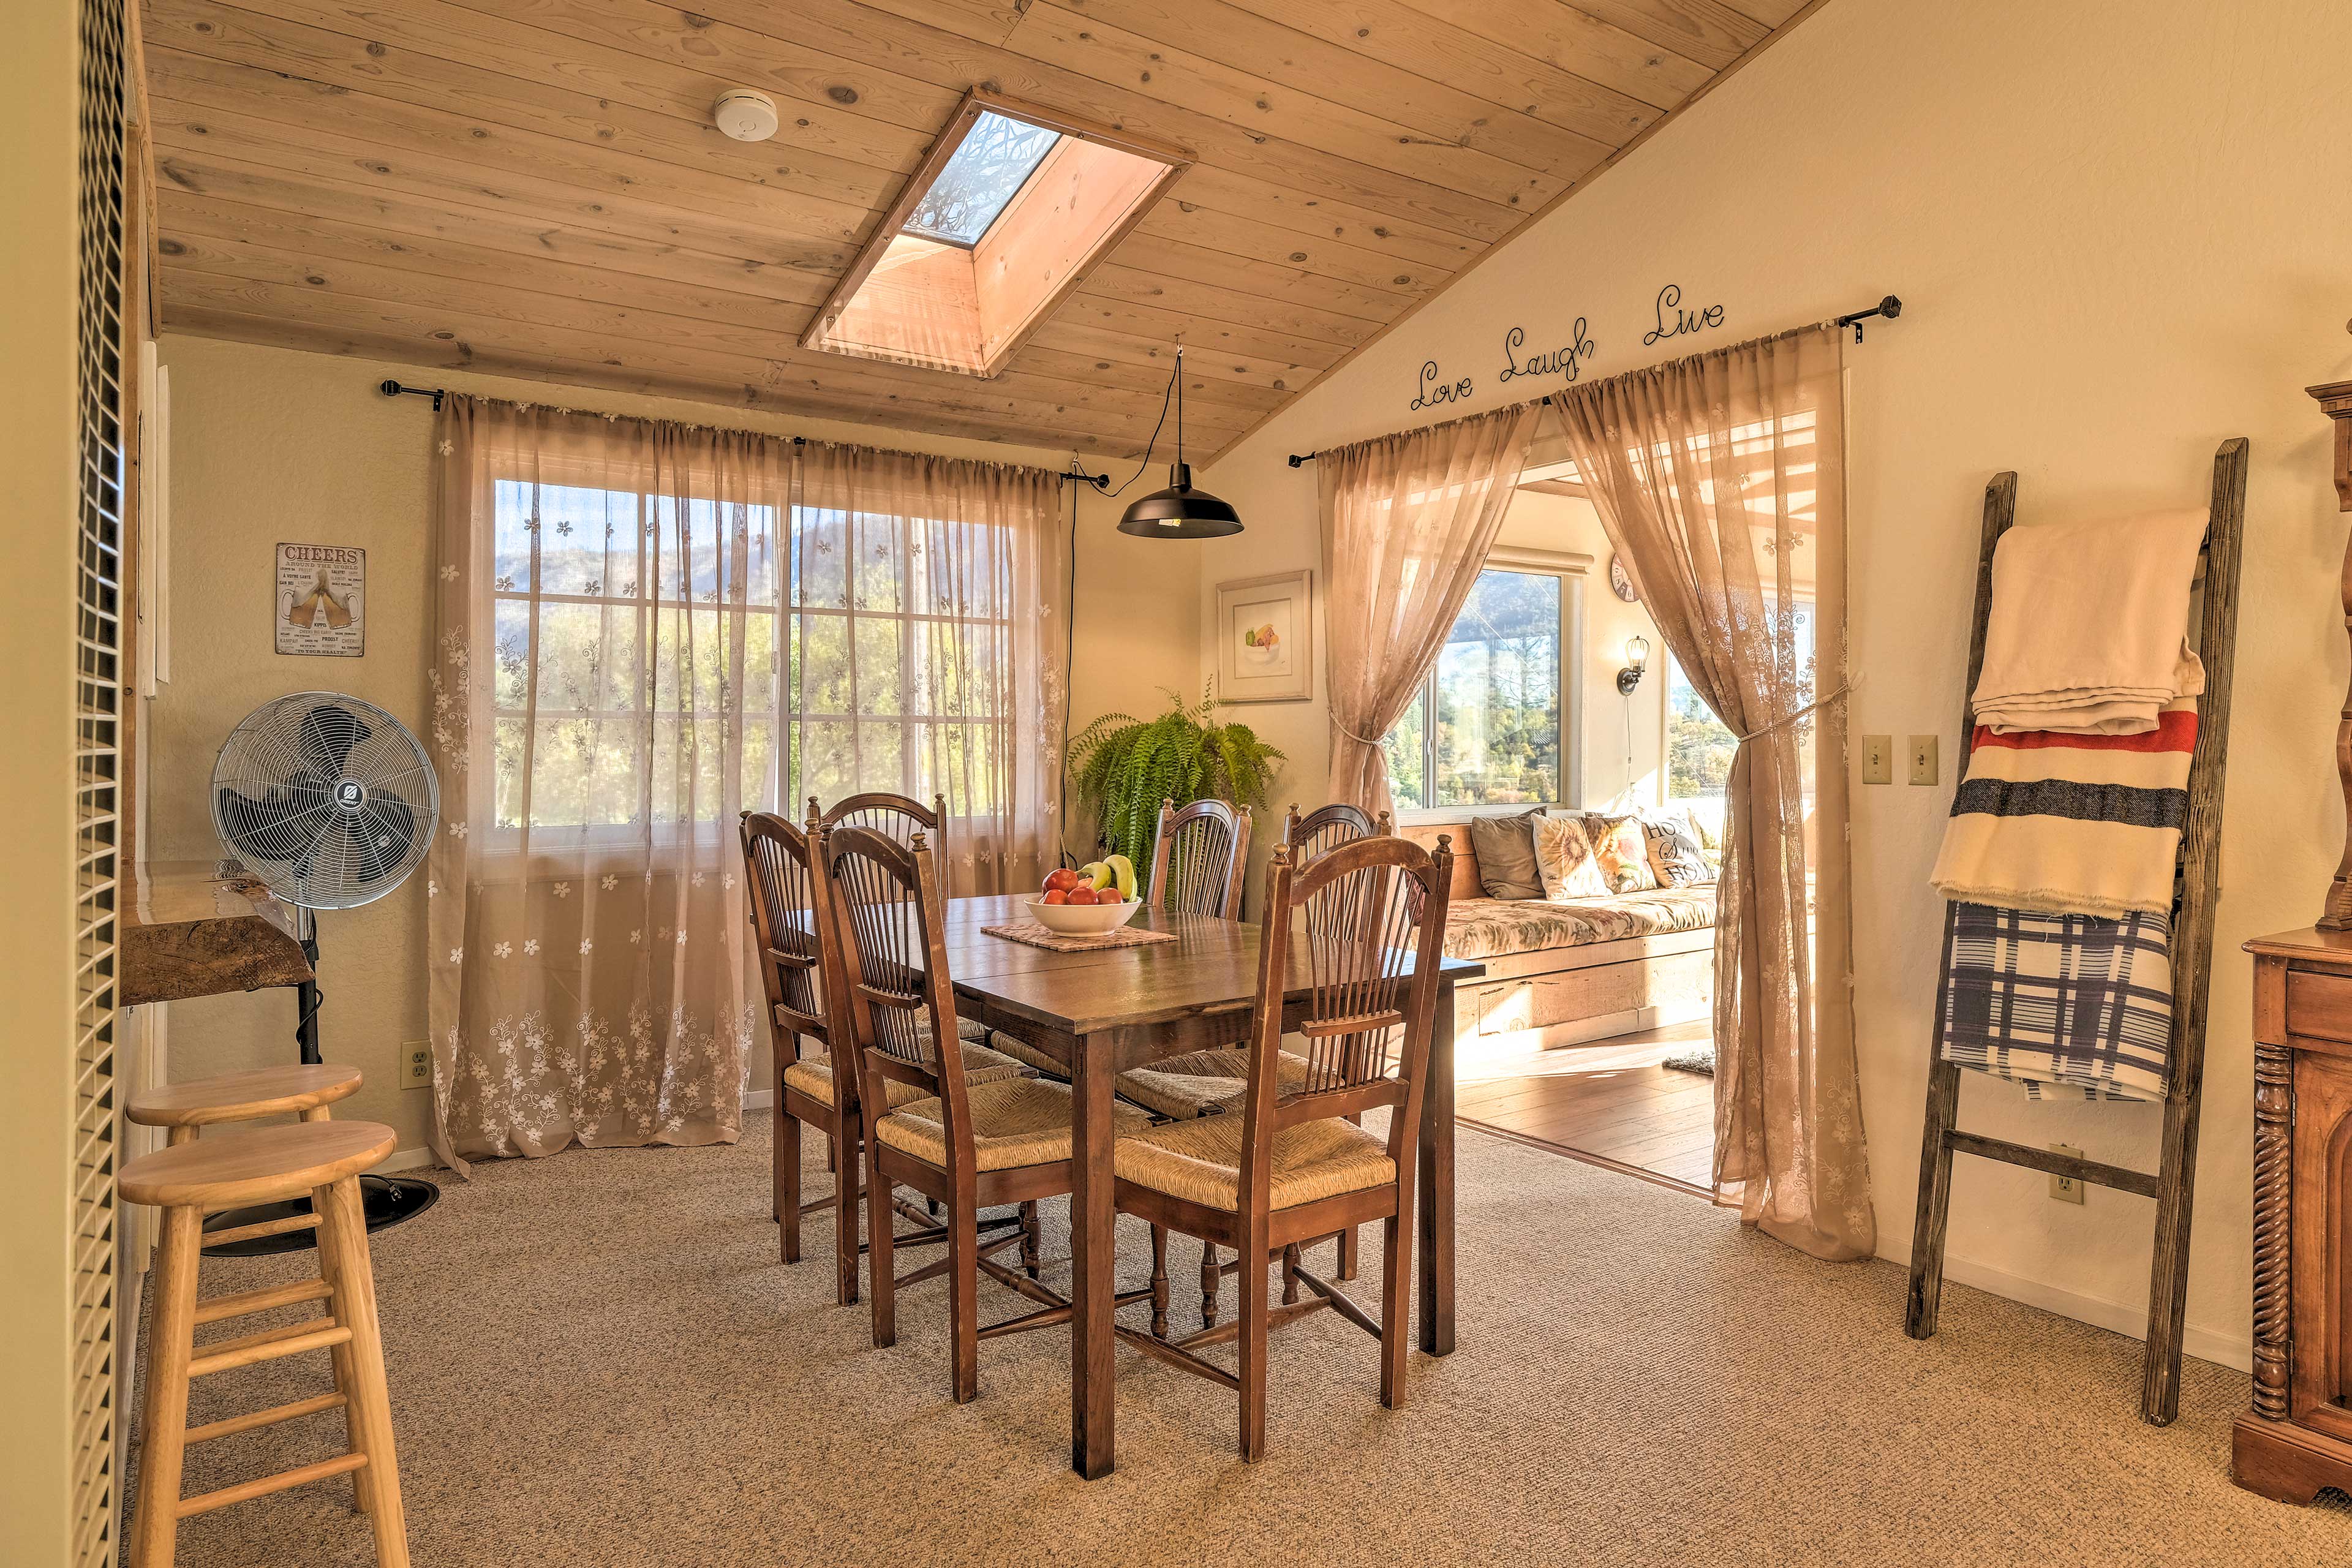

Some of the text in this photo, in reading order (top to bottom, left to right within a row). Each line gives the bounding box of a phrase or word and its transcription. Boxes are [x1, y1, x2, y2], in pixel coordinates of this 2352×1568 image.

[1411, 284, 1725, 411] Love Laugh Live
[285, 546, 358, 564] CHEERS
